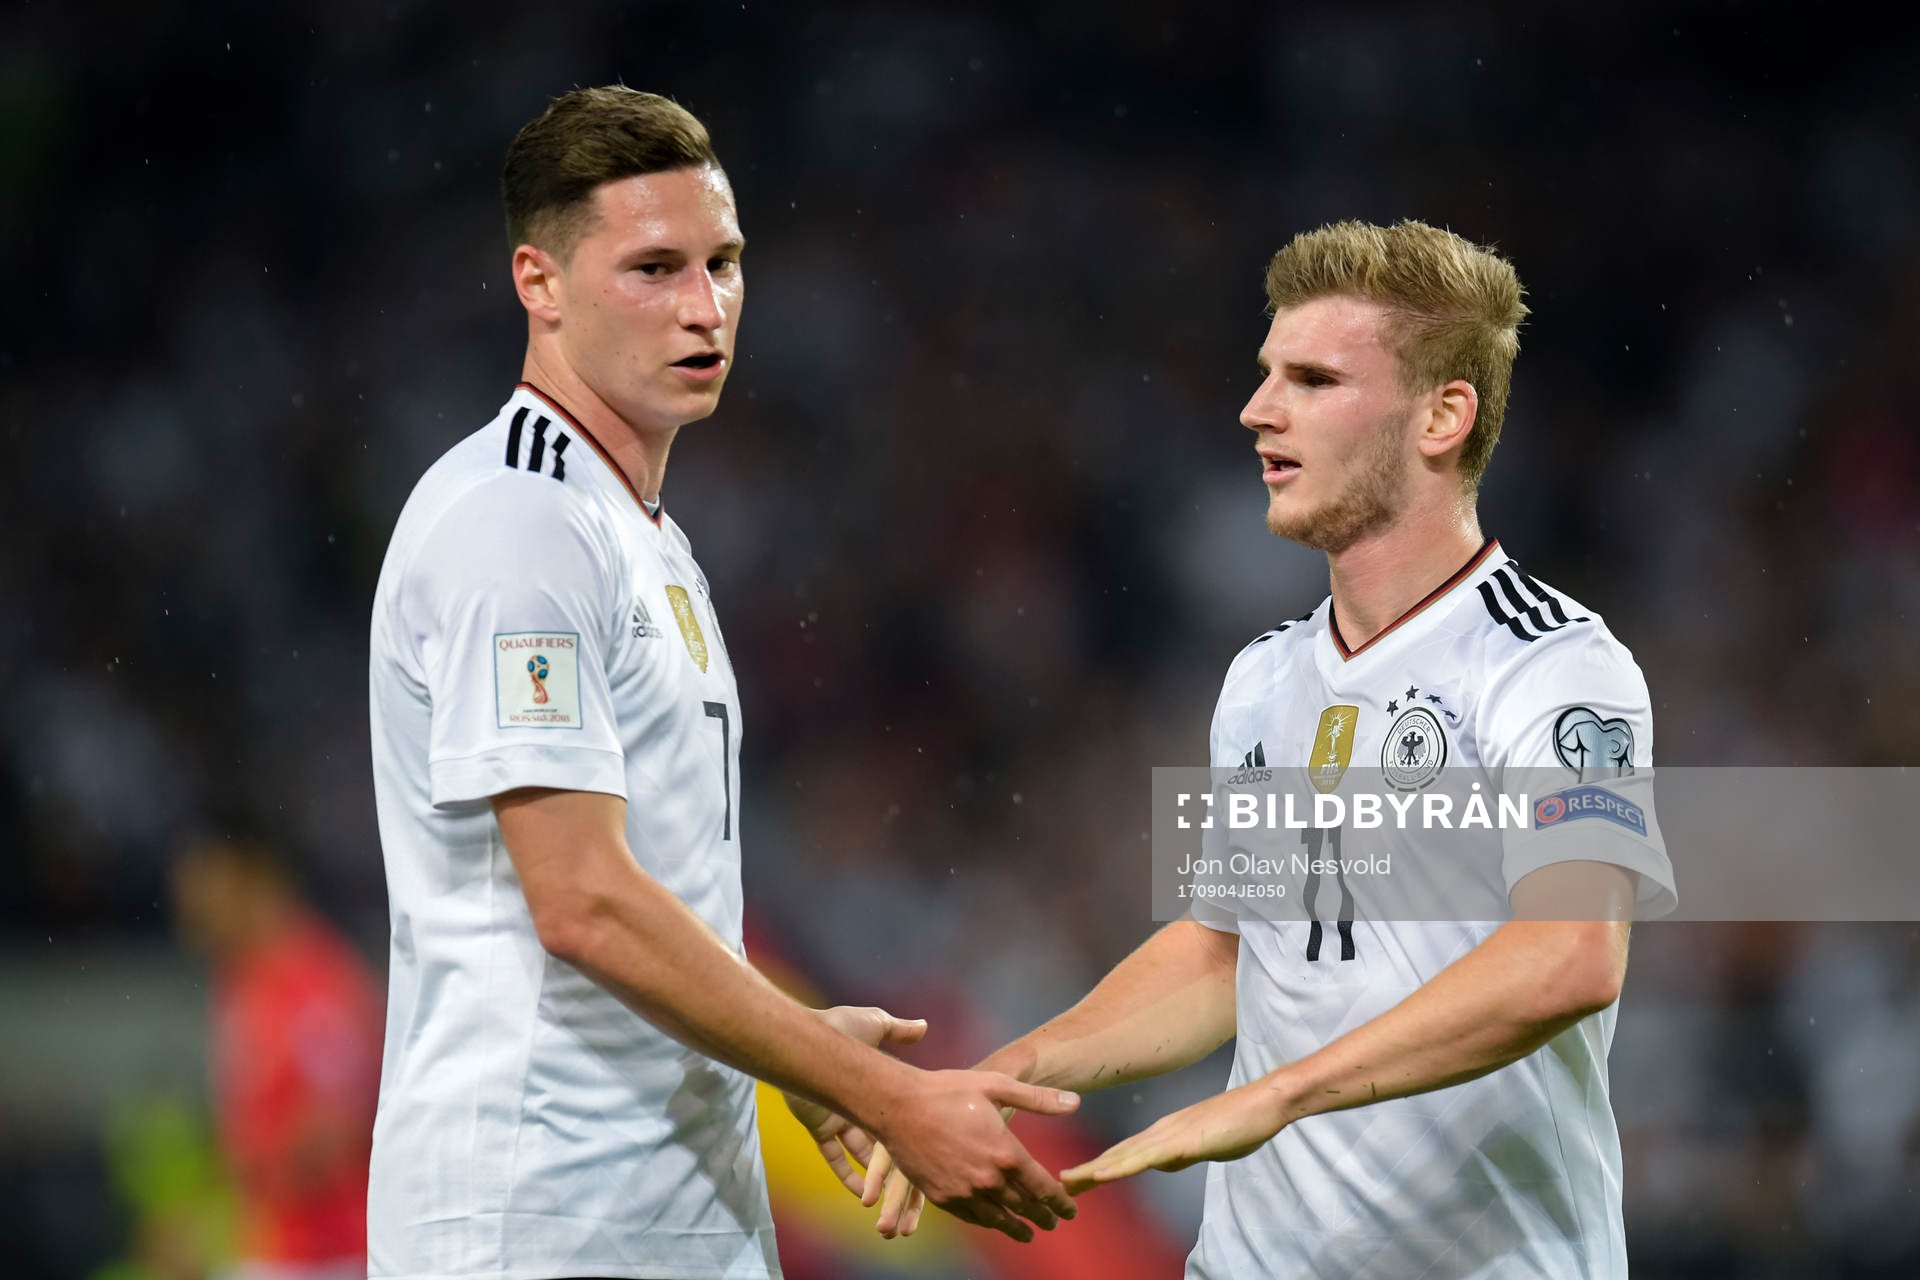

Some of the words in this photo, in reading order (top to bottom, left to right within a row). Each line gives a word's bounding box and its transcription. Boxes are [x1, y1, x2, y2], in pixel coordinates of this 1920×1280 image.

[499, 637, 574, 651] QUALIFIERS
[1397, 717, 1431, 734] DEUTSCHER
[703, 701, 731, 840] 7
[1227, 766, 1273, 785] adidas
[1320, 762, 1340, 775] FIFA
[1568, 794, 1644, 828] RESPECT
[1300, 826, 1355, 961] 11
